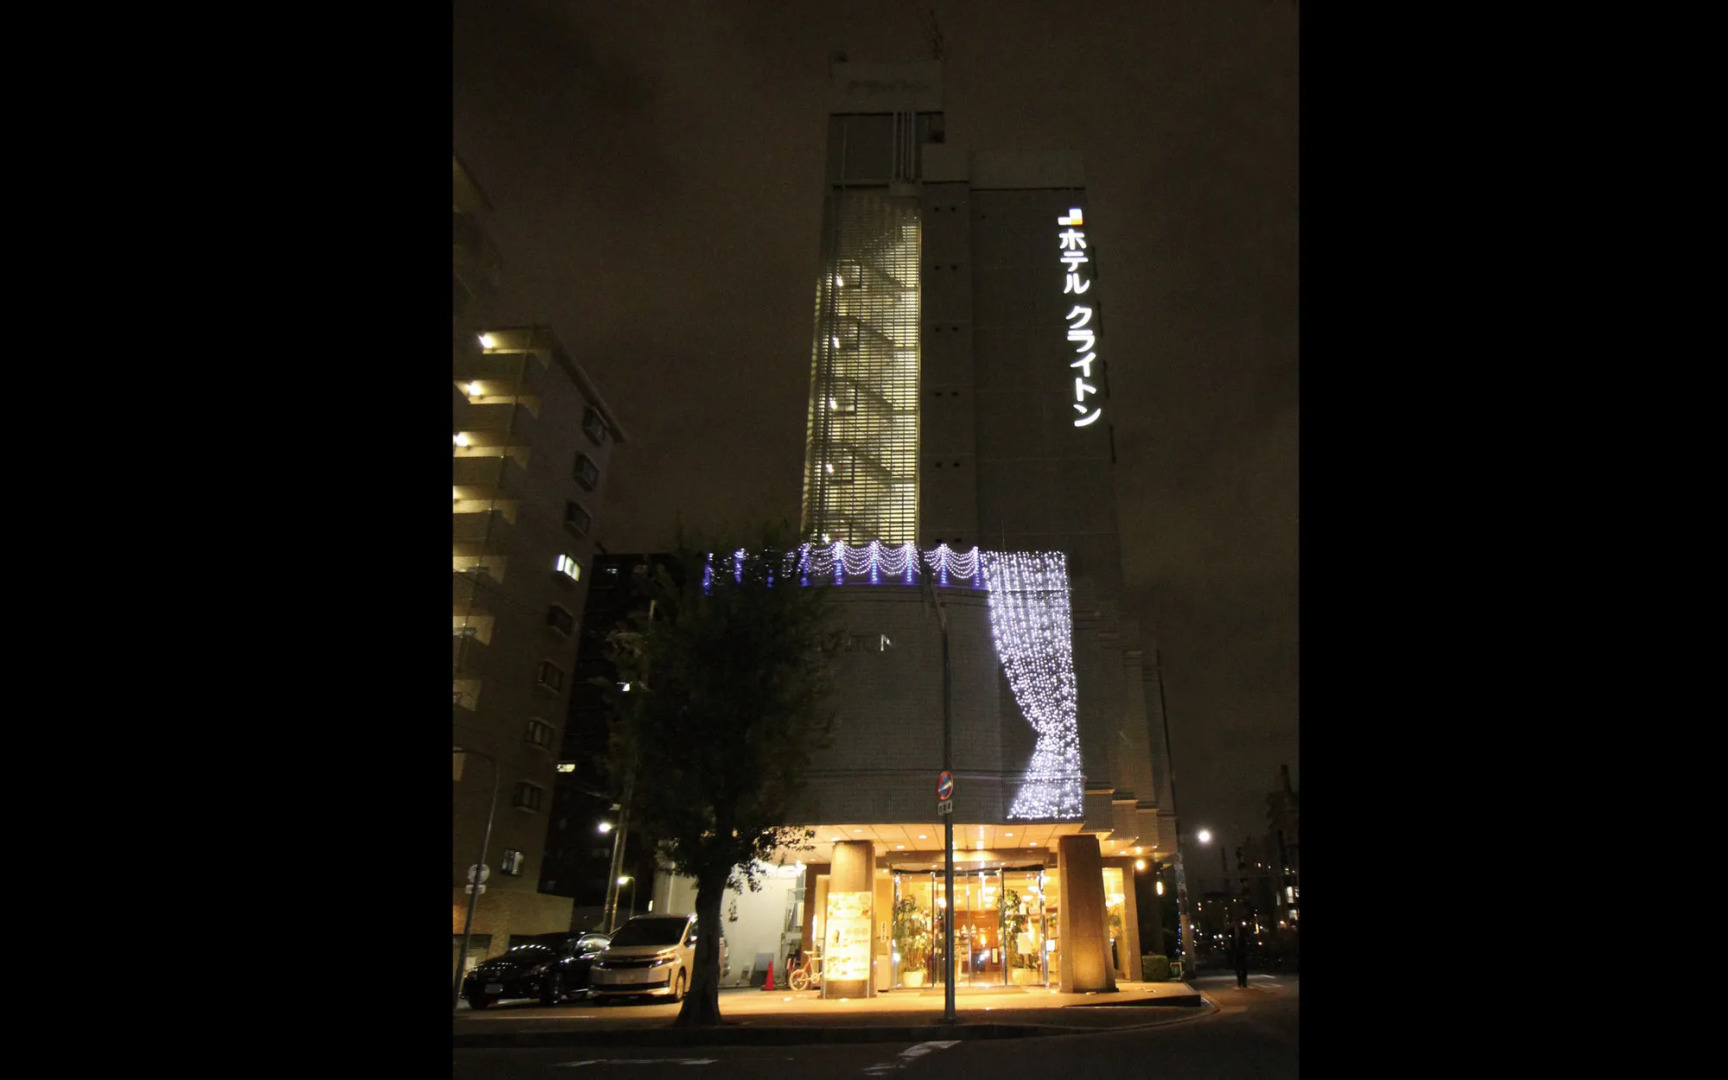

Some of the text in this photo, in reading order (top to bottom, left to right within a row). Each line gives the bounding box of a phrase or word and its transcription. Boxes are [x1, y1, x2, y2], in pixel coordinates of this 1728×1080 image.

[1058, 228, 1102, 428] ホテル クライトン
